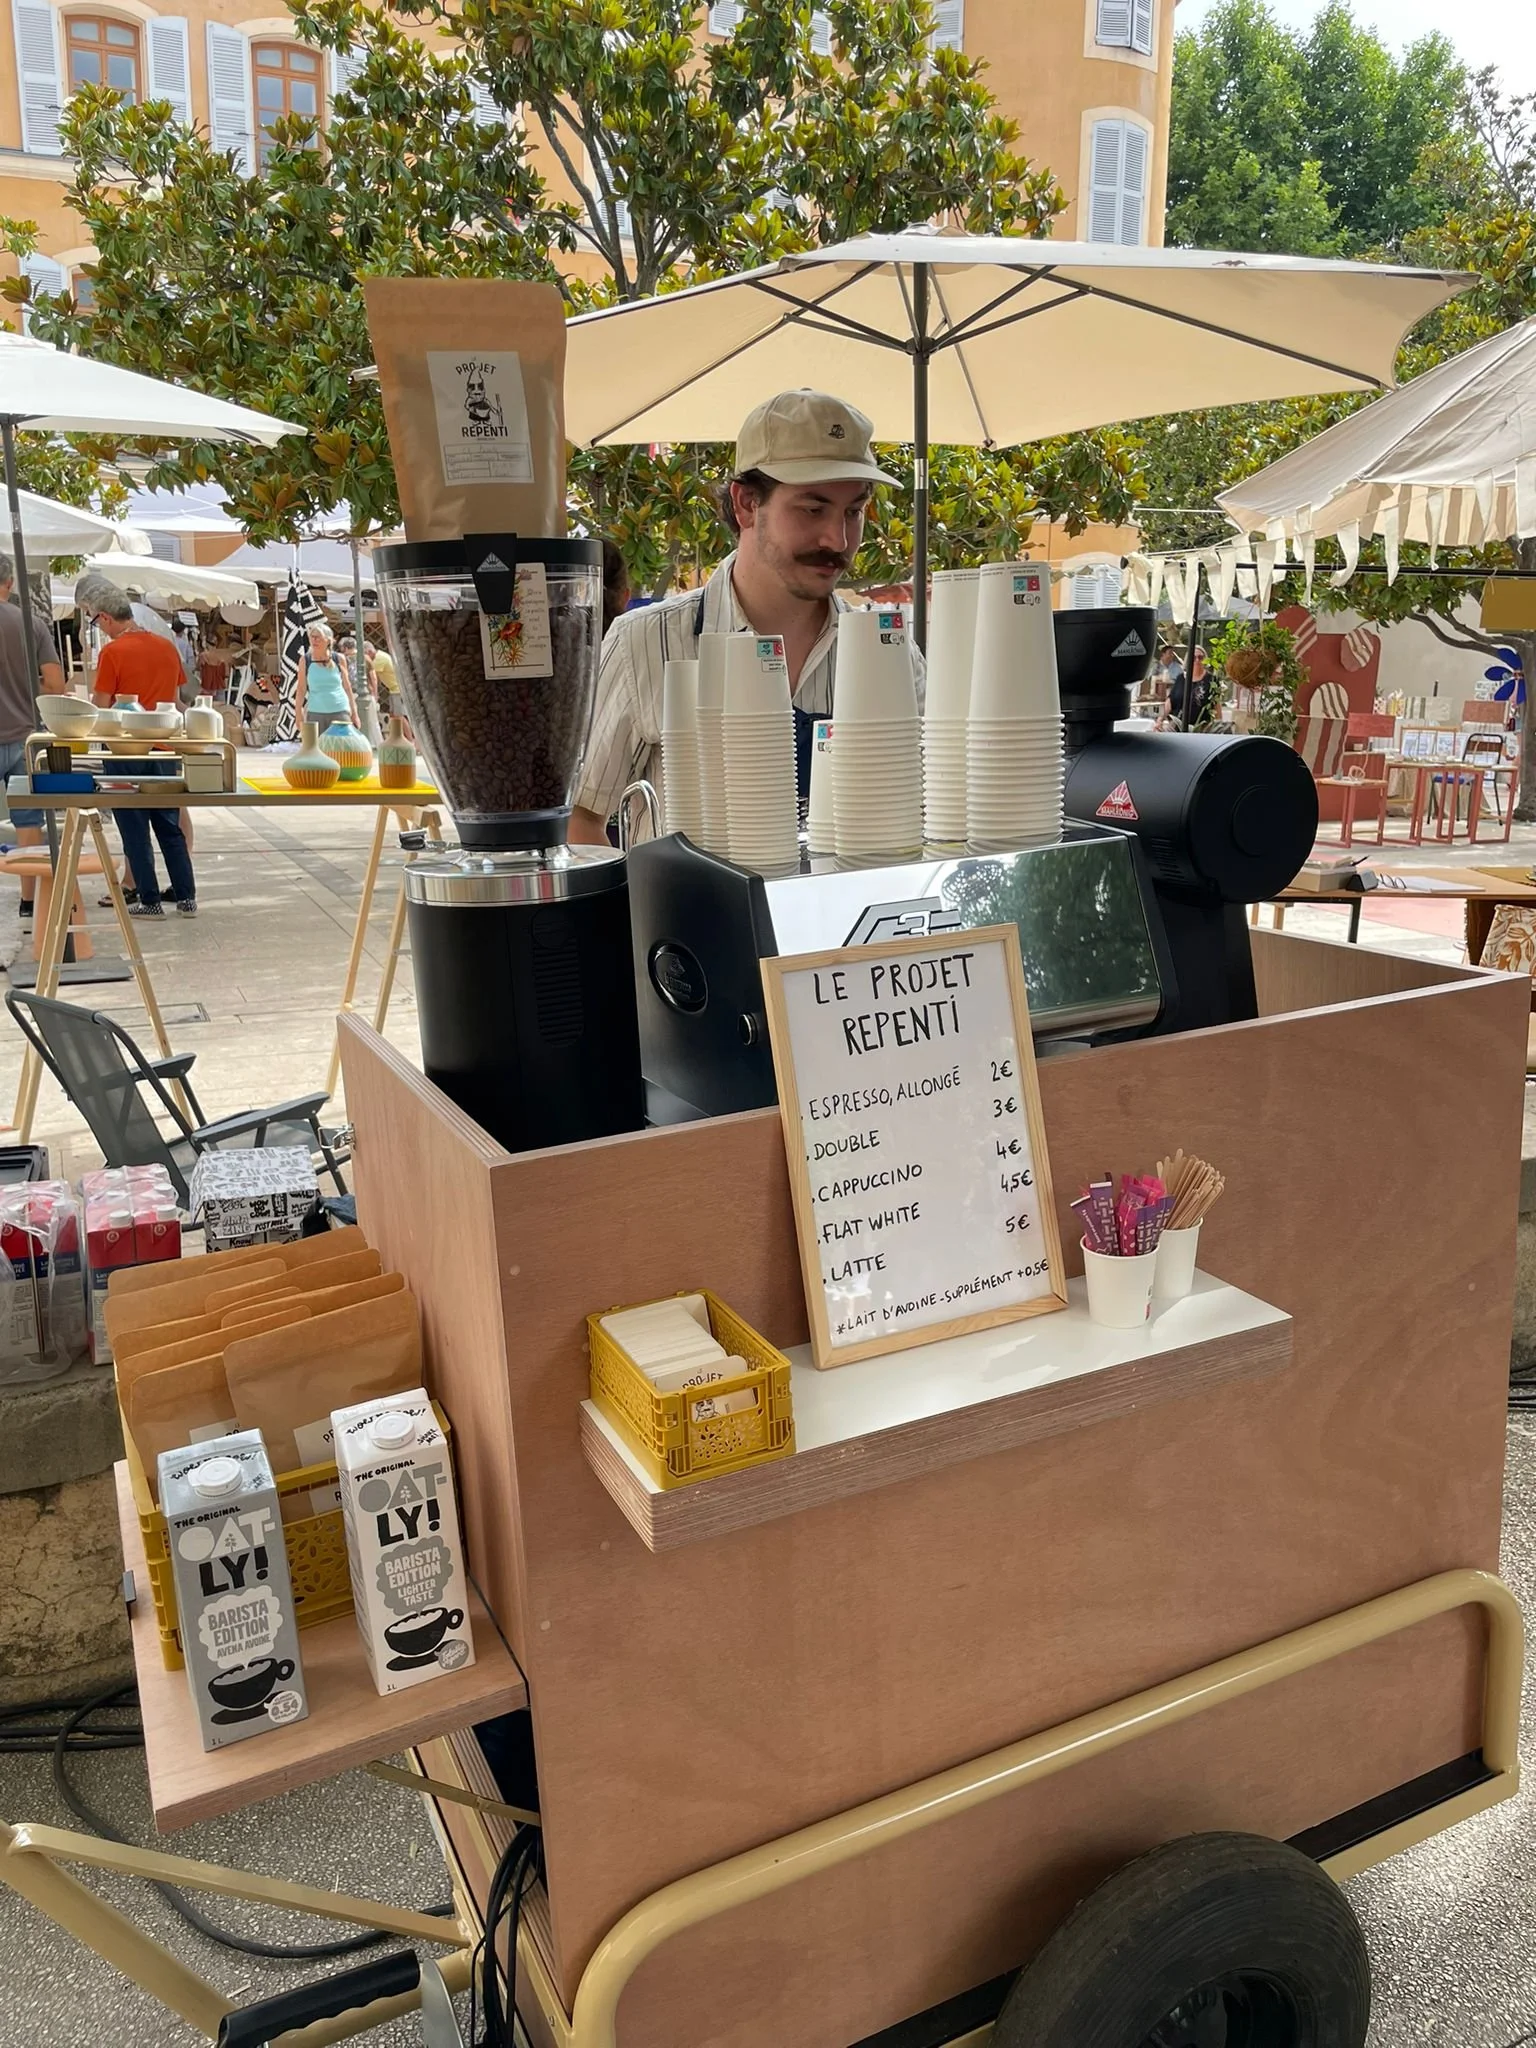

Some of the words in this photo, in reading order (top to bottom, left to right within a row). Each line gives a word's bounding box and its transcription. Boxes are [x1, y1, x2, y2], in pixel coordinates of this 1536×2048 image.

[461, 426, 508, 437] REPENTI
[813, 971, 849, 1004] LE
[870, 953, 975, 999] PROJET
[842, 994, 960, 1056] REPENTI
[991, 1060, 1013, 1082] 2€
[809, 1088, 893, 1120] ESPRESSO,
[896, 1065, 961, 1101] ALLONGÉ
[993, 1097, 1017, 1118] 3€
[814, 1130, 880, 1160] DOUBLE
[996, 1139, 1022, 1159] 4€
[818, 1164, 923, 1202] CAPPUCCINO
[1001, 1170, 1033, 1193] 4,5€
[822, 1219, 863, 1244] FLAT
[868, 1202, 920, 1231] WHITE
[1005, 1214, 1030, 1233] 5€
[831, 1253, 887, 1281] LATTE
[354, 1471, 374, 1482] THE
[374, 1459, 416, 1476] ORIGINAL
[174, 1517, 195, 1528] THE
[198, 1506, 242, 1522] ORIGINAL
[376, 1498, 441, 1547] LY!
[199, 1546, 269, 1597] LY!
[384, 1547, 441, 1576] BARISTA
[388, 1561, 442, 1589] EDITION
[398, 1578, 437, 1598] LIGHTER
[403, 1589, 435, 1607] TASTE
[207, 1599, 269, 1631] BARISTA
[213, 1615, 270, 1647] EDITION
